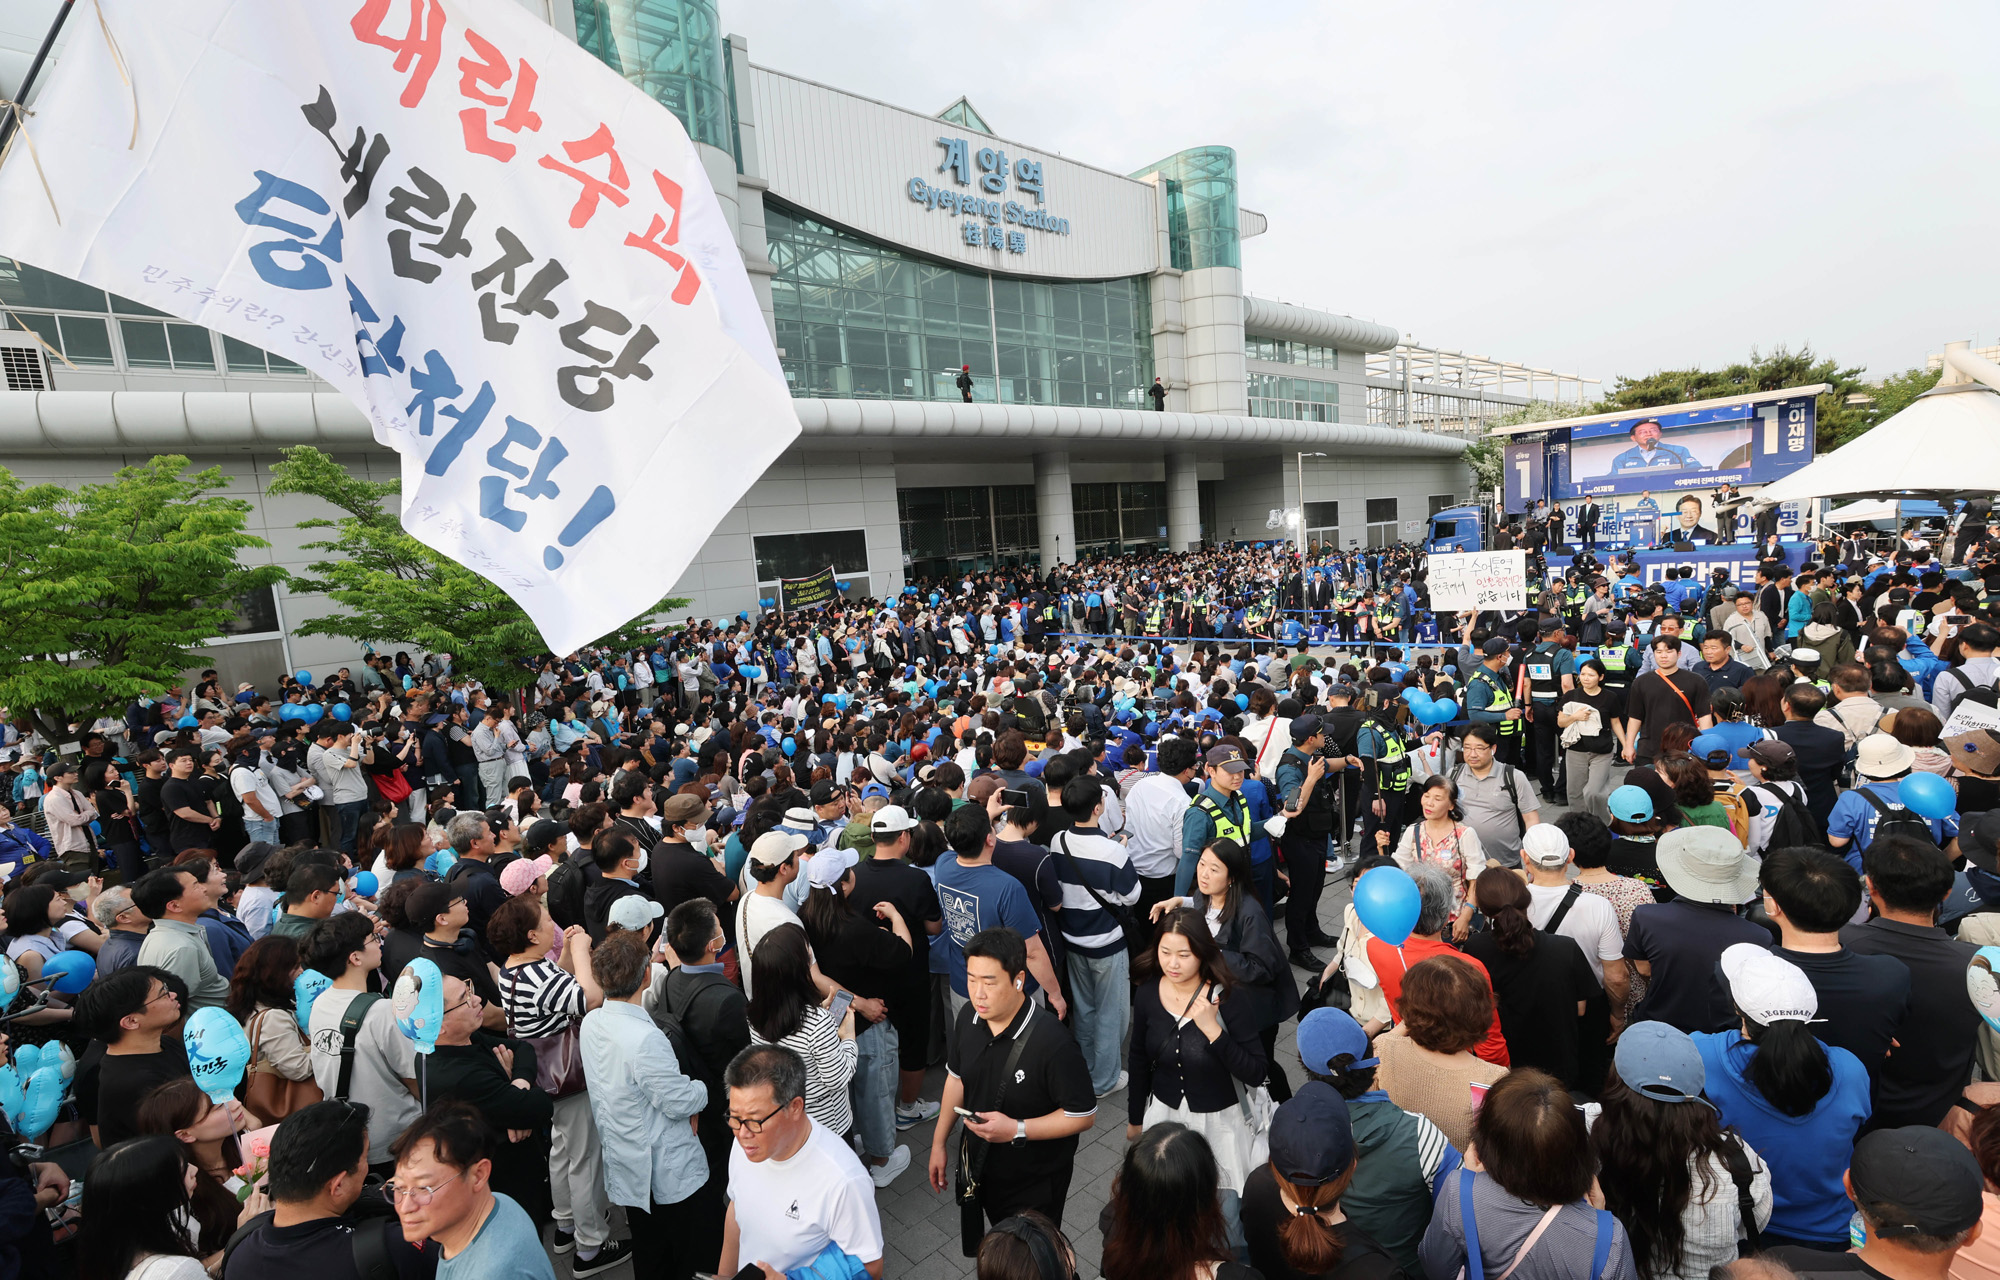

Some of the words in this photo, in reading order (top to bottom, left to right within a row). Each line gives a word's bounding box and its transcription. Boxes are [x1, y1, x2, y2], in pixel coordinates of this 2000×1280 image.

[937, 136, 1045, 203] 계양역
[909, 176, 1001, 224] Gyeyang
[1005, 200, 1070, 235] Station
[964, 220, 1027, 254] 桂陽驛
[142, 264, 286, 330] 민주주의란?
[1757, 405, 1779, 455] 1
[1788, 409, 1806, 452] 이재명
[1515, 460, 1531, 499] 1
[1576, 484, 1582, 495] 1
[1593, 484, 1615, 494] 이재명
[1469, 556, 1513, 577] 수어통역
[1431, 581, 1467, 596] 전국에서
[1477, 590, 1521, 605] 없습니다
